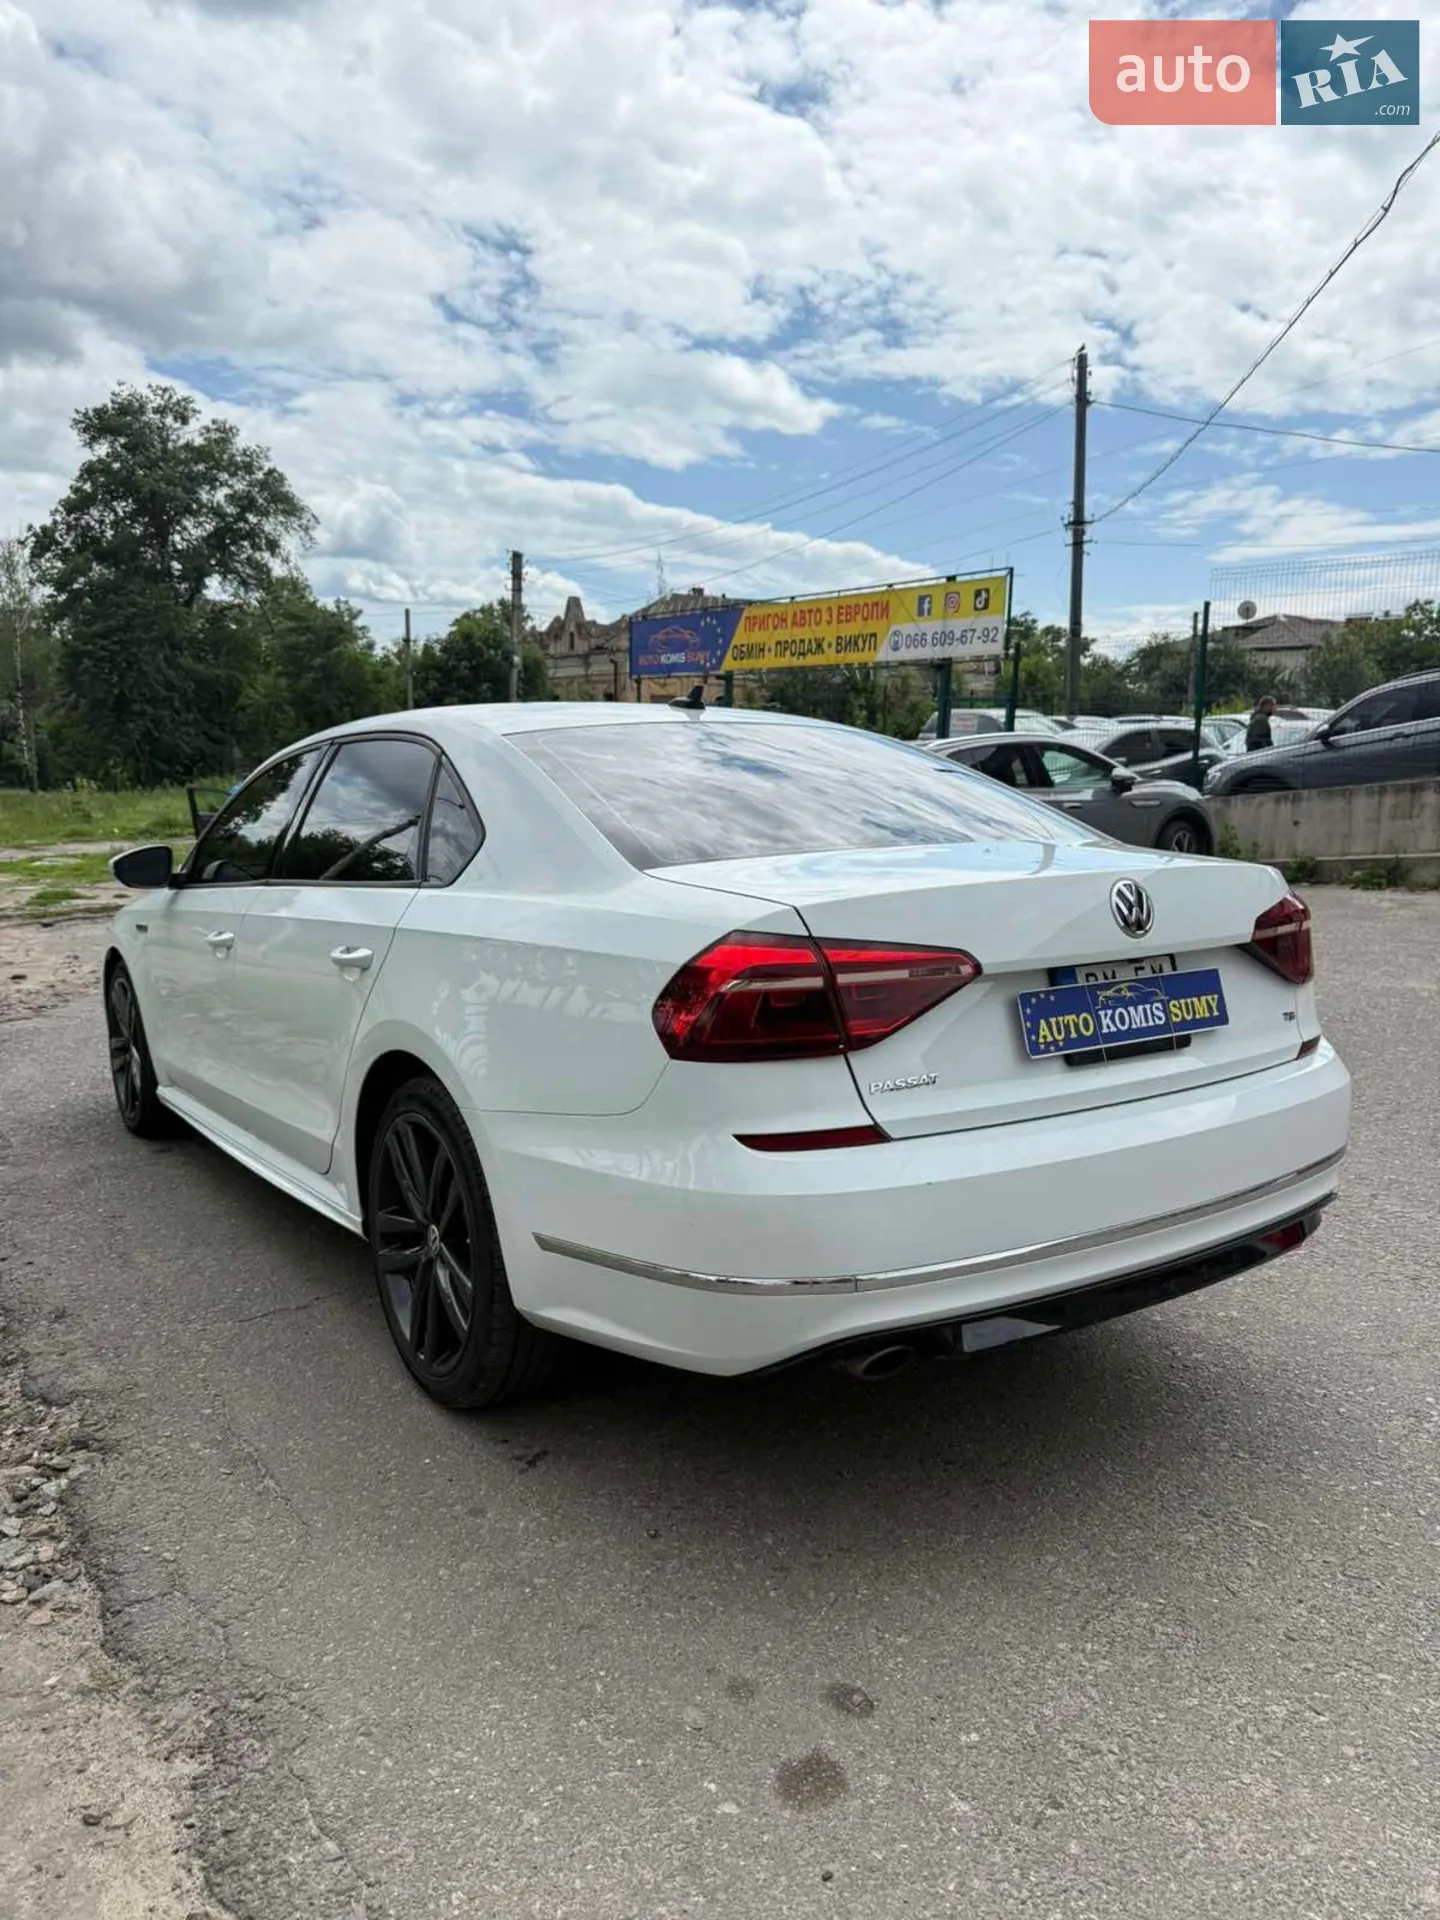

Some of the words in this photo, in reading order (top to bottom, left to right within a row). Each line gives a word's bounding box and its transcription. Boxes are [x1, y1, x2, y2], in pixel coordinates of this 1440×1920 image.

[744, 611, 788, 634] ПРИГОН
[791, 607, 822, 629] АВТО
[837, 601, 890, 625] ЕВРОПИ
[731, 642, 766, 662] ОБМІН
[774, 636, 825, 660] ПРОДАЖ
[835, 632, 878, 654] ВИКУП
[1037, 1012, 1095, 1044] AUTO
[1098, 1001, 1166, 1034] KOMIS
[1168, 994, 1220, 1023] SUMY
[868, 1072, 939, 1095] PASSAT
